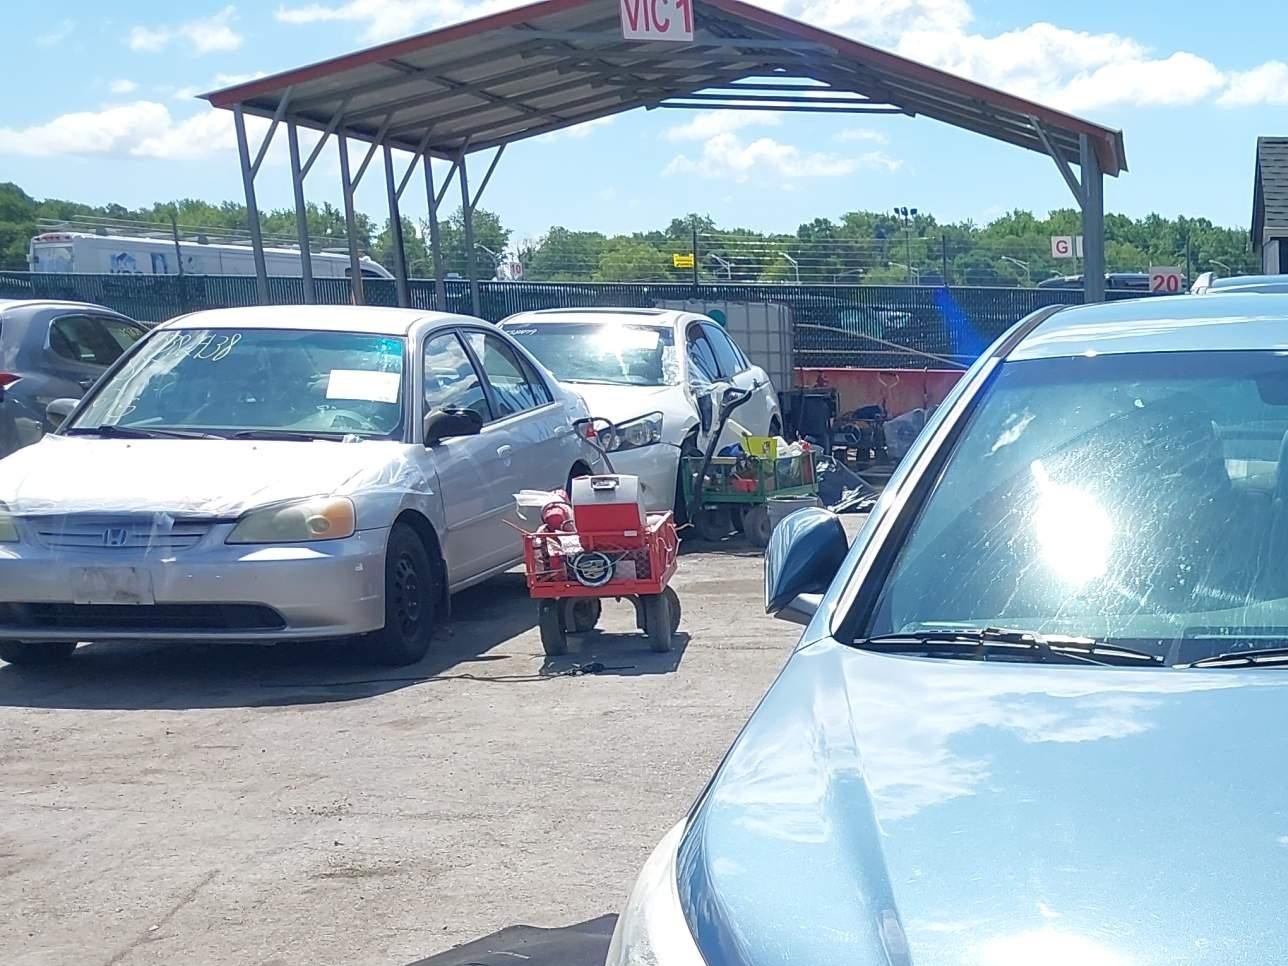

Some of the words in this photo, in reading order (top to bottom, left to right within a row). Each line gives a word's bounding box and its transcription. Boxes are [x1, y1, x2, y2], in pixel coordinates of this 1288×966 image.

[624, 0, 670, 33] VIC
[675, 0, 692, 33] 1
[1056, 240, 1068, 254] G
[511, 264, 522, 274] 10
[1153, 274, 1179, 293] 20
